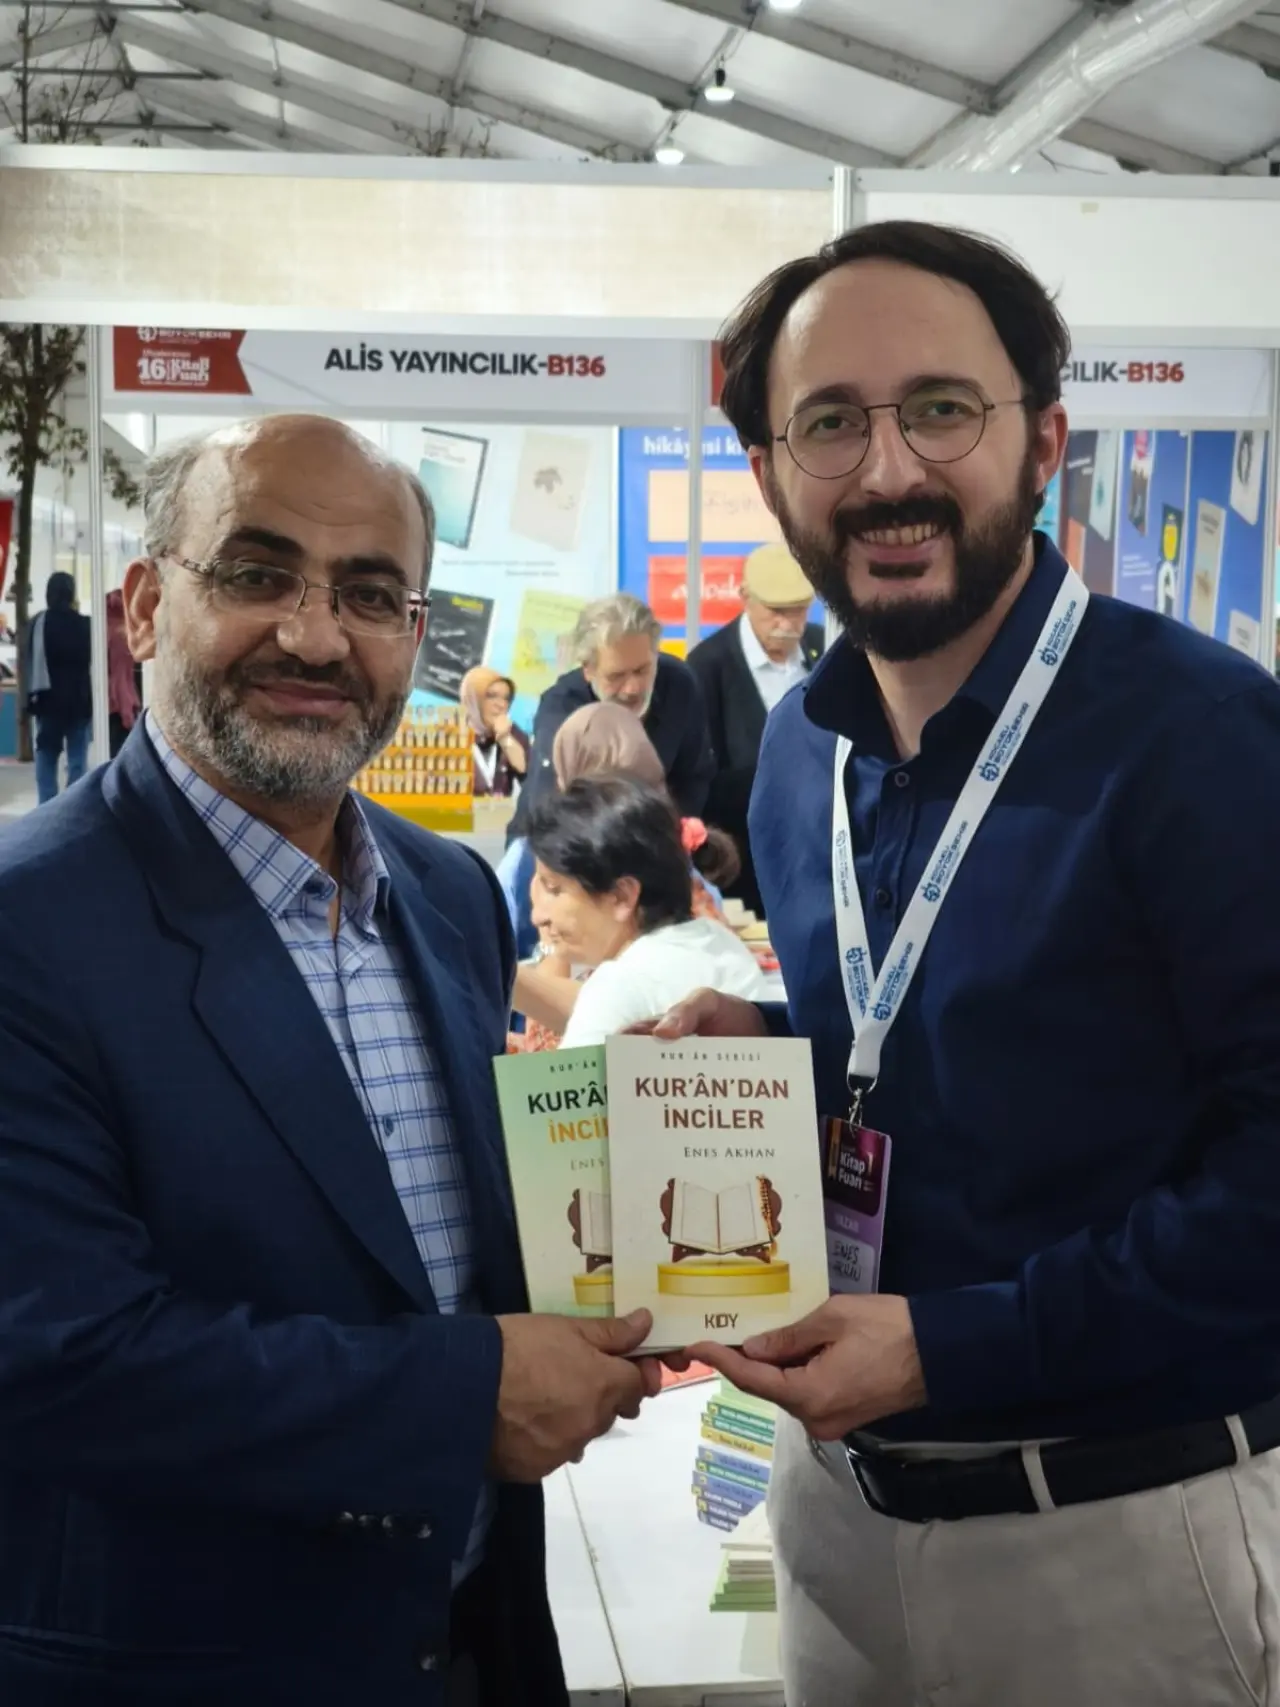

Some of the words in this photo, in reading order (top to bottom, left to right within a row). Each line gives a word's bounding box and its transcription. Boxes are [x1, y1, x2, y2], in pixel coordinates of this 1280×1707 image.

[137, 358, 166, 380] 16
[324, 342, 383, 371] ALİS
[390, 349, 606, 377] YAYINCILIK-B136
[527, 1081, 608, 1114] KUR'Â
[635, 1072, 789, 1099] KUR'ÂN'DAN
[664, 1104, 765, 1129] İNCİLER
[684, 1146, 718, 1158] ENES
[725, 1147, 776, 1158] AKHAN
[840, 1151, 865, 1174] Kitap
